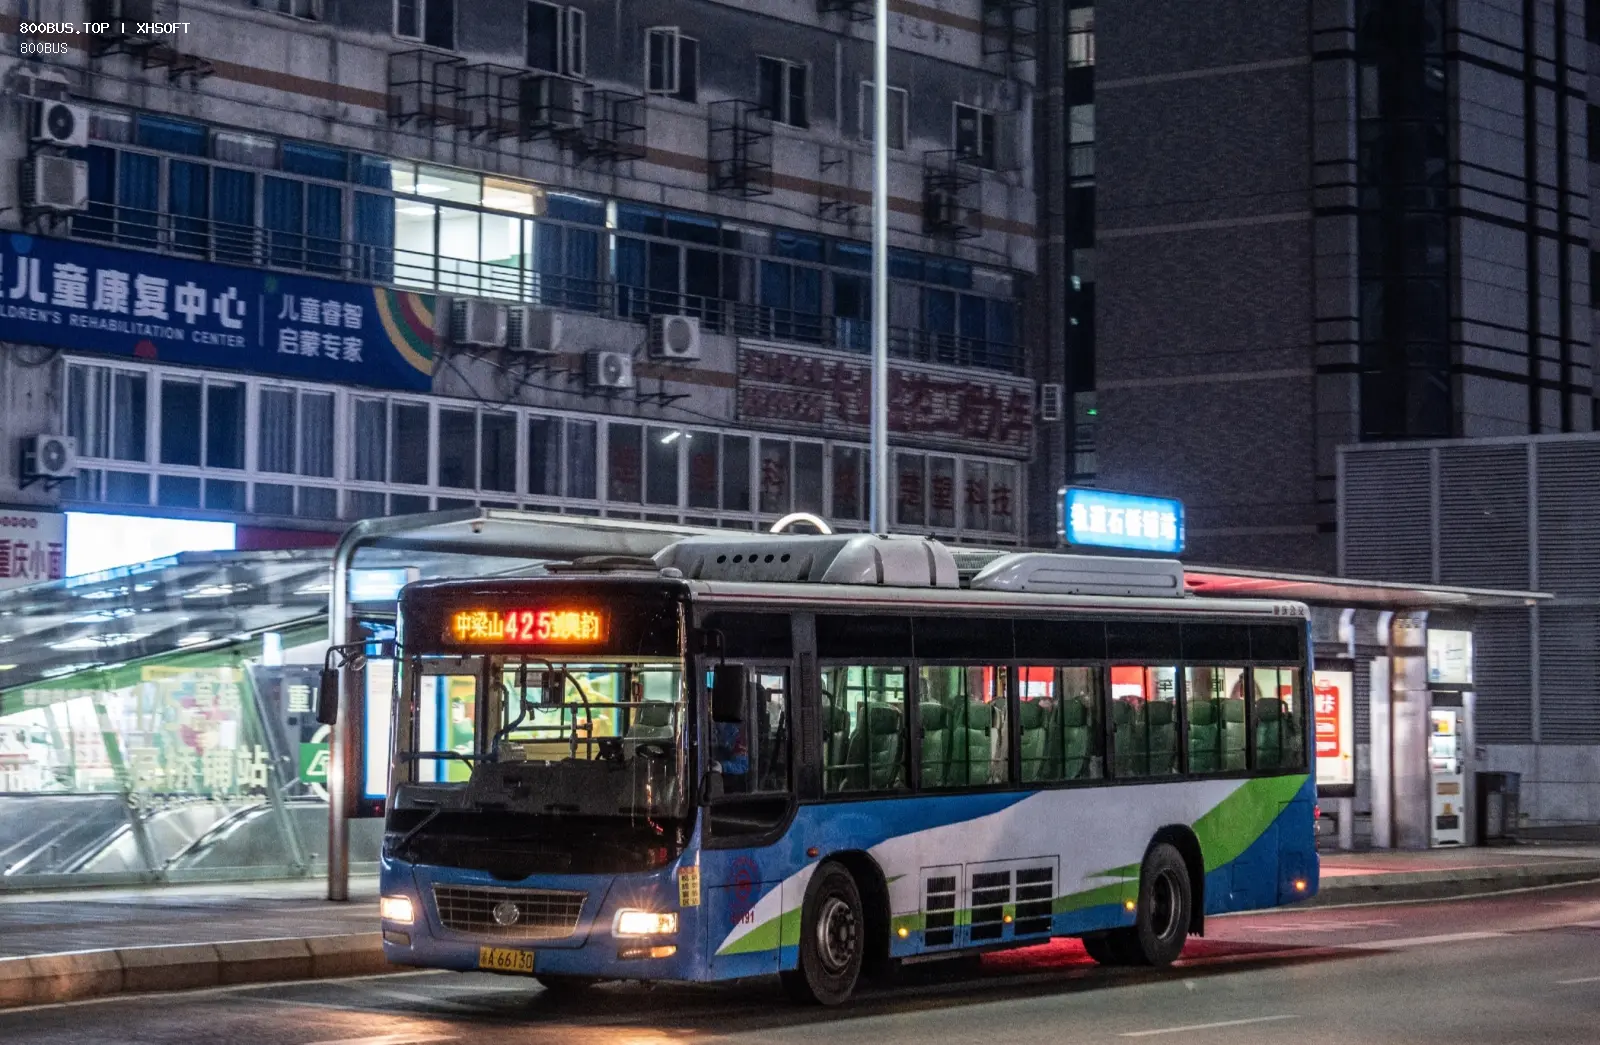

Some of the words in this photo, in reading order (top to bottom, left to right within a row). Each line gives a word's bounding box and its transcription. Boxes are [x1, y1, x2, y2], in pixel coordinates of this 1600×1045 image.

[0, 254, 246, 329] 儿童康复中心
[278, 293, 363, 330] 儿童睿智
[69, 313, 185, 341] REHABILITATION
[192, 330, 246, 348] CENTER
[277, 327, 363, 363] 启蒙专家
[505, 612, 549, 640] 425
